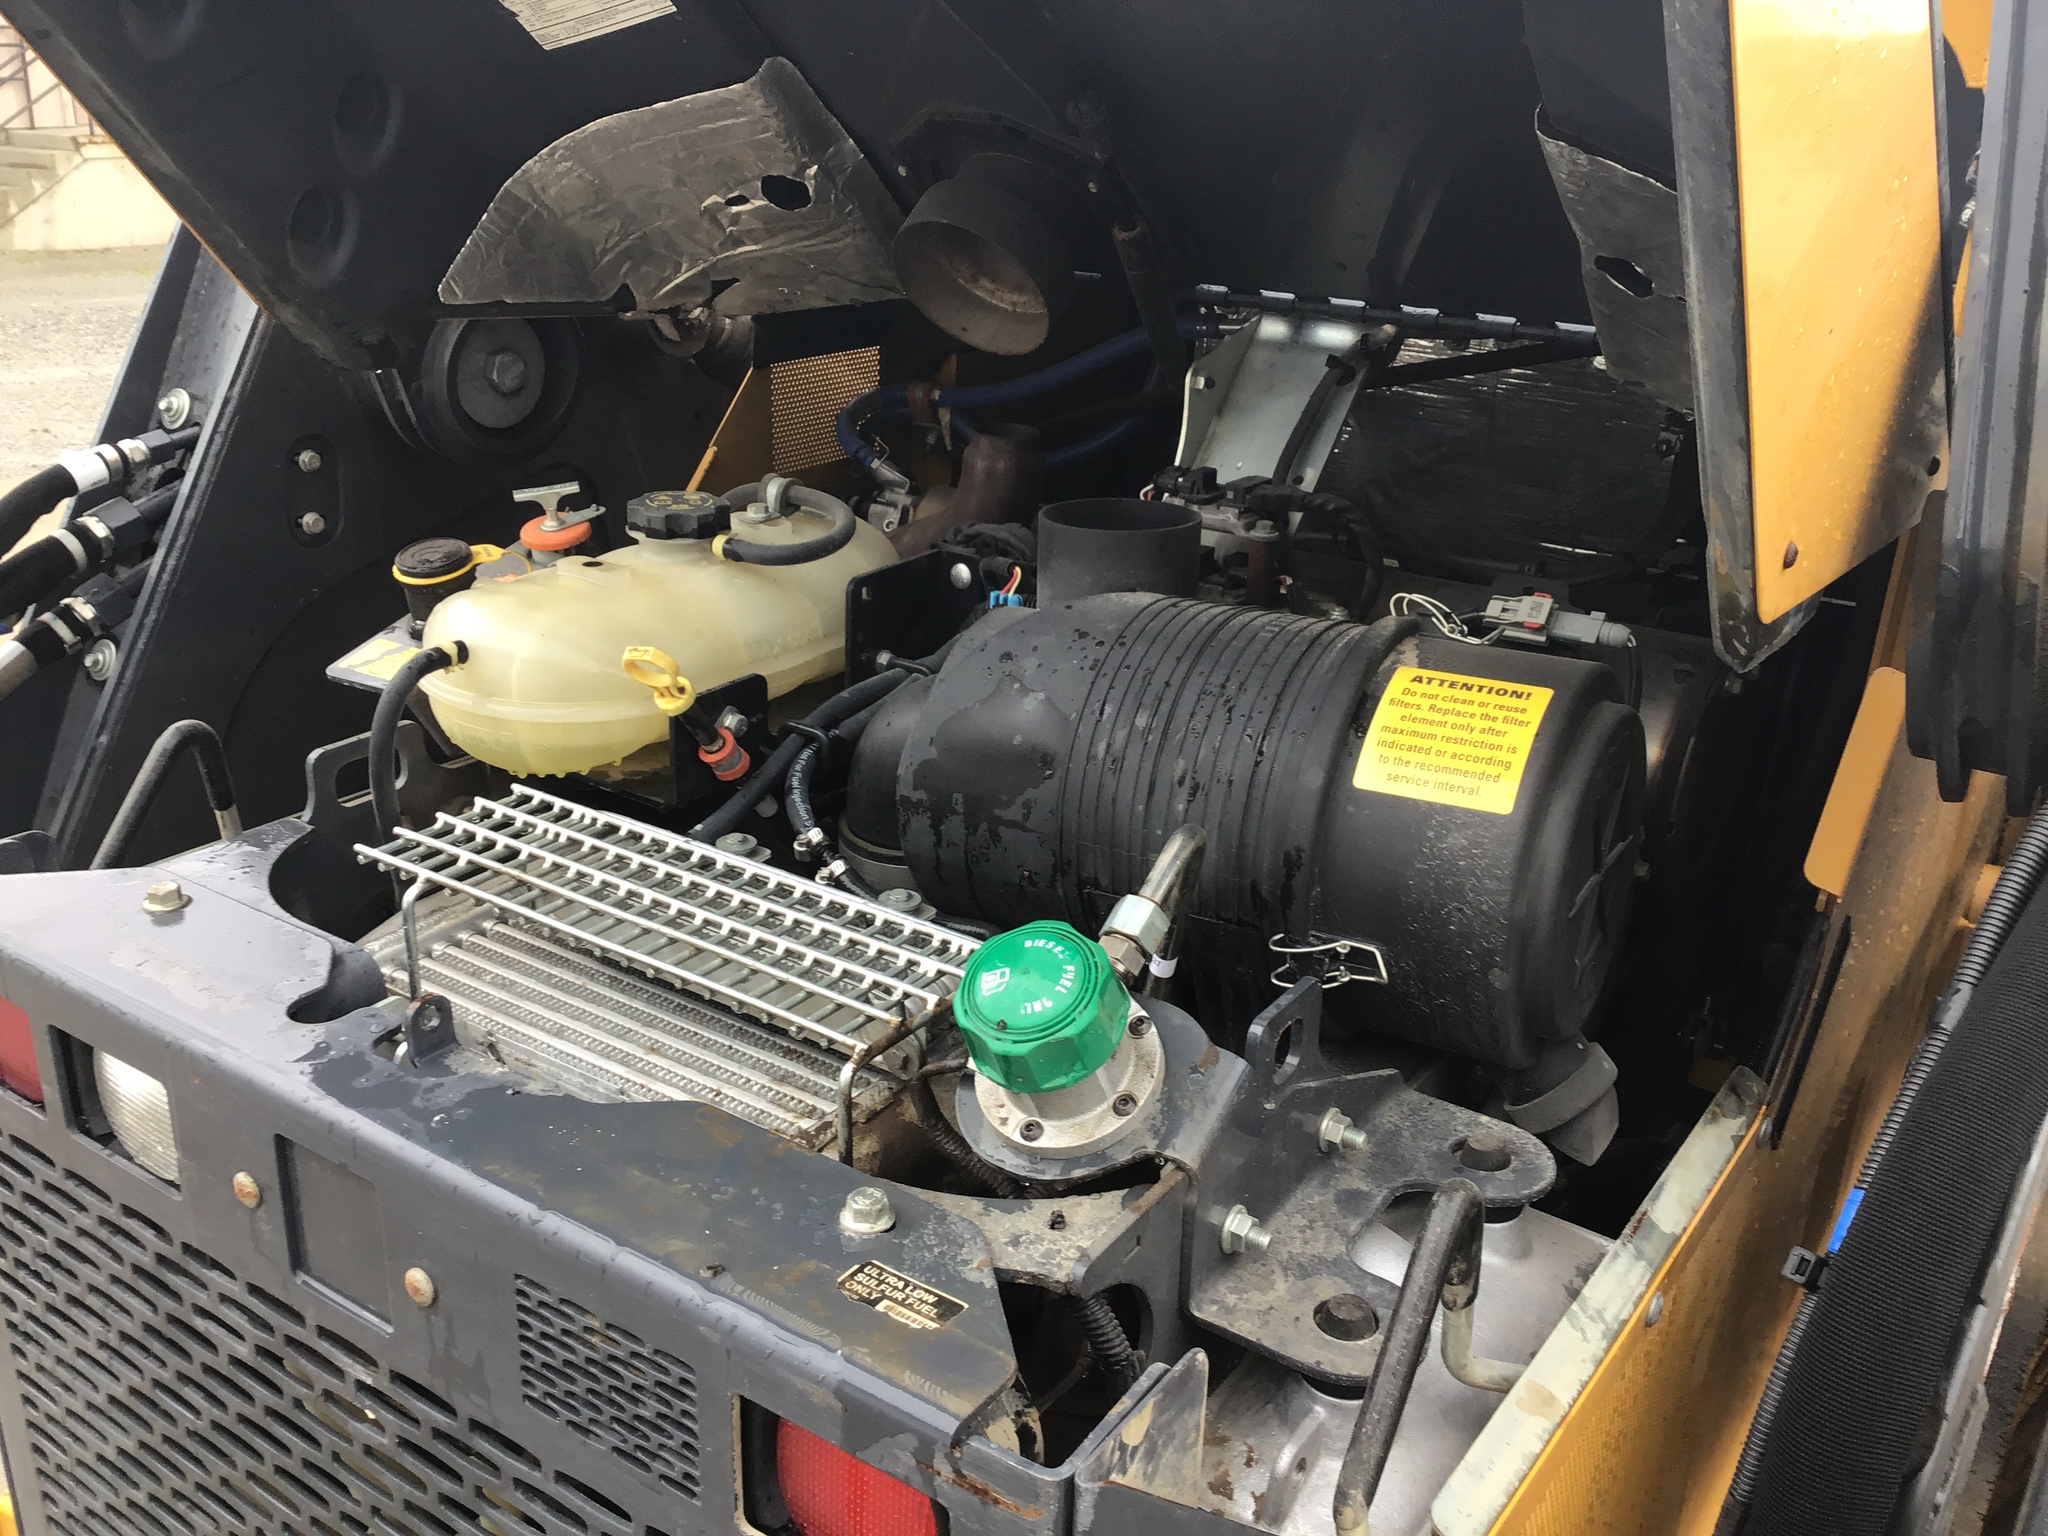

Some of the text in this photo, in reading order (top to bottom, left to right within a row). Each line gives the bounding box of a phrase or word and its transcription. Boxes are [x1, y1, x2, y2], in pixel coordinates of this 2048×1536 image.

[1401, 687, 1528, 715] Do not clean or reuse
[1409, 674, 1533, 701] ATTENTION!
[1388, 698, 1532, 729] filters. Replace the filter
[1400, 713, 1508, 738] element only after
[1380, 725, 1518, 754] maximum restriction is
[1376, 738, 1512, 771] indicated or according
[1378, 754, 1501, 784] to the recommended
[791, 772, 802, 788] Fuel
[1386, 772, 1482, 797] service interval.
[791, 788, 809, 820] Injection
[1054, 964, 1075, 994] FUEL
[844, 1281, 882, 1300] ONLY
[853, 1272, 907, 1301] SULFUR
[904, 1298, 938, 1318] FUEL
[862, 1265, 939, 1304] ULTRA LOW
